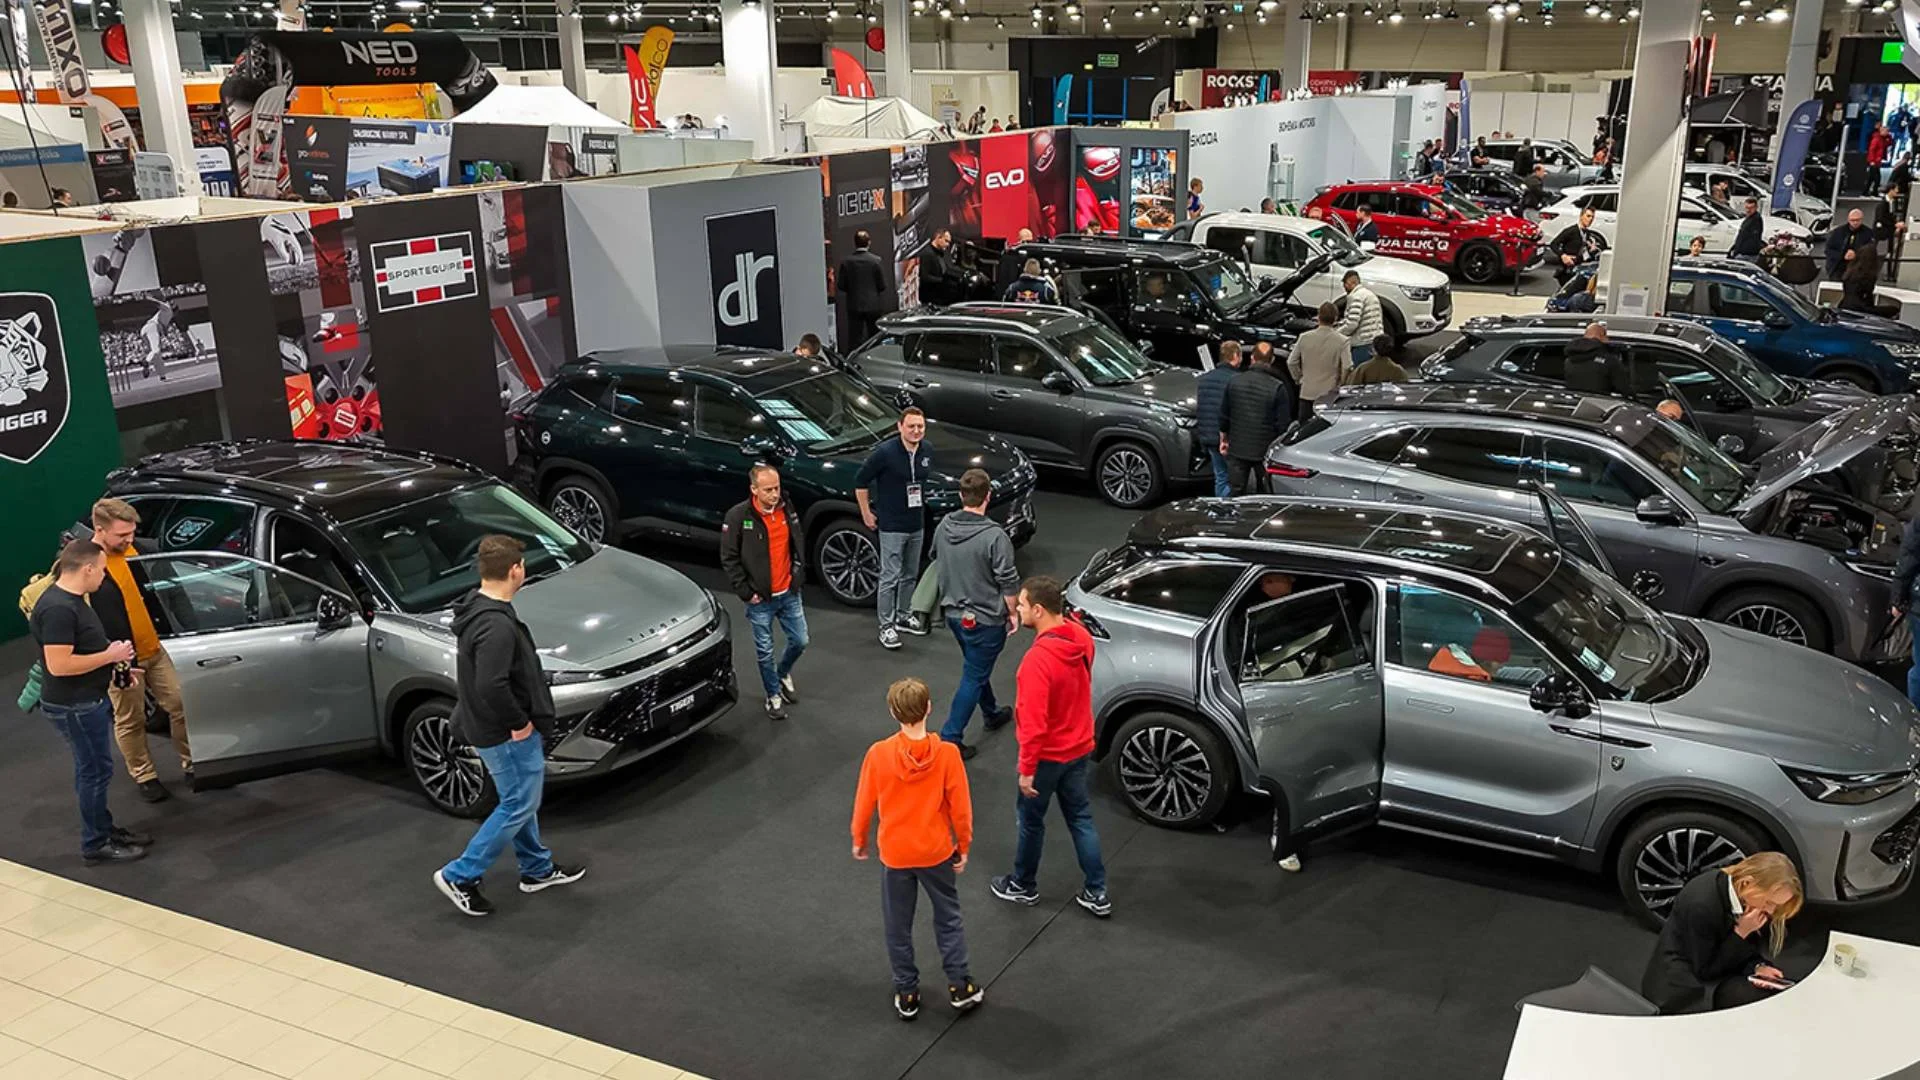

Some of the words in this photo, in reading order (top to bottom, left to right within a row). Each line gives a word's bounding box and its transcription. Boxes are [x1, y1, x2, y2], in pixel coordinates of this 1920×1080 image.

[341, 41, 418, 65] NEO
[375, 66, 417, 77] TOOLS
[1206, 74, 1255, 88] ROCKS
[985, 168, 1025, 190] EVO
[387, 261, 464, 282] SPORTEQUIPE
[718, 251, 775, 327] dr
